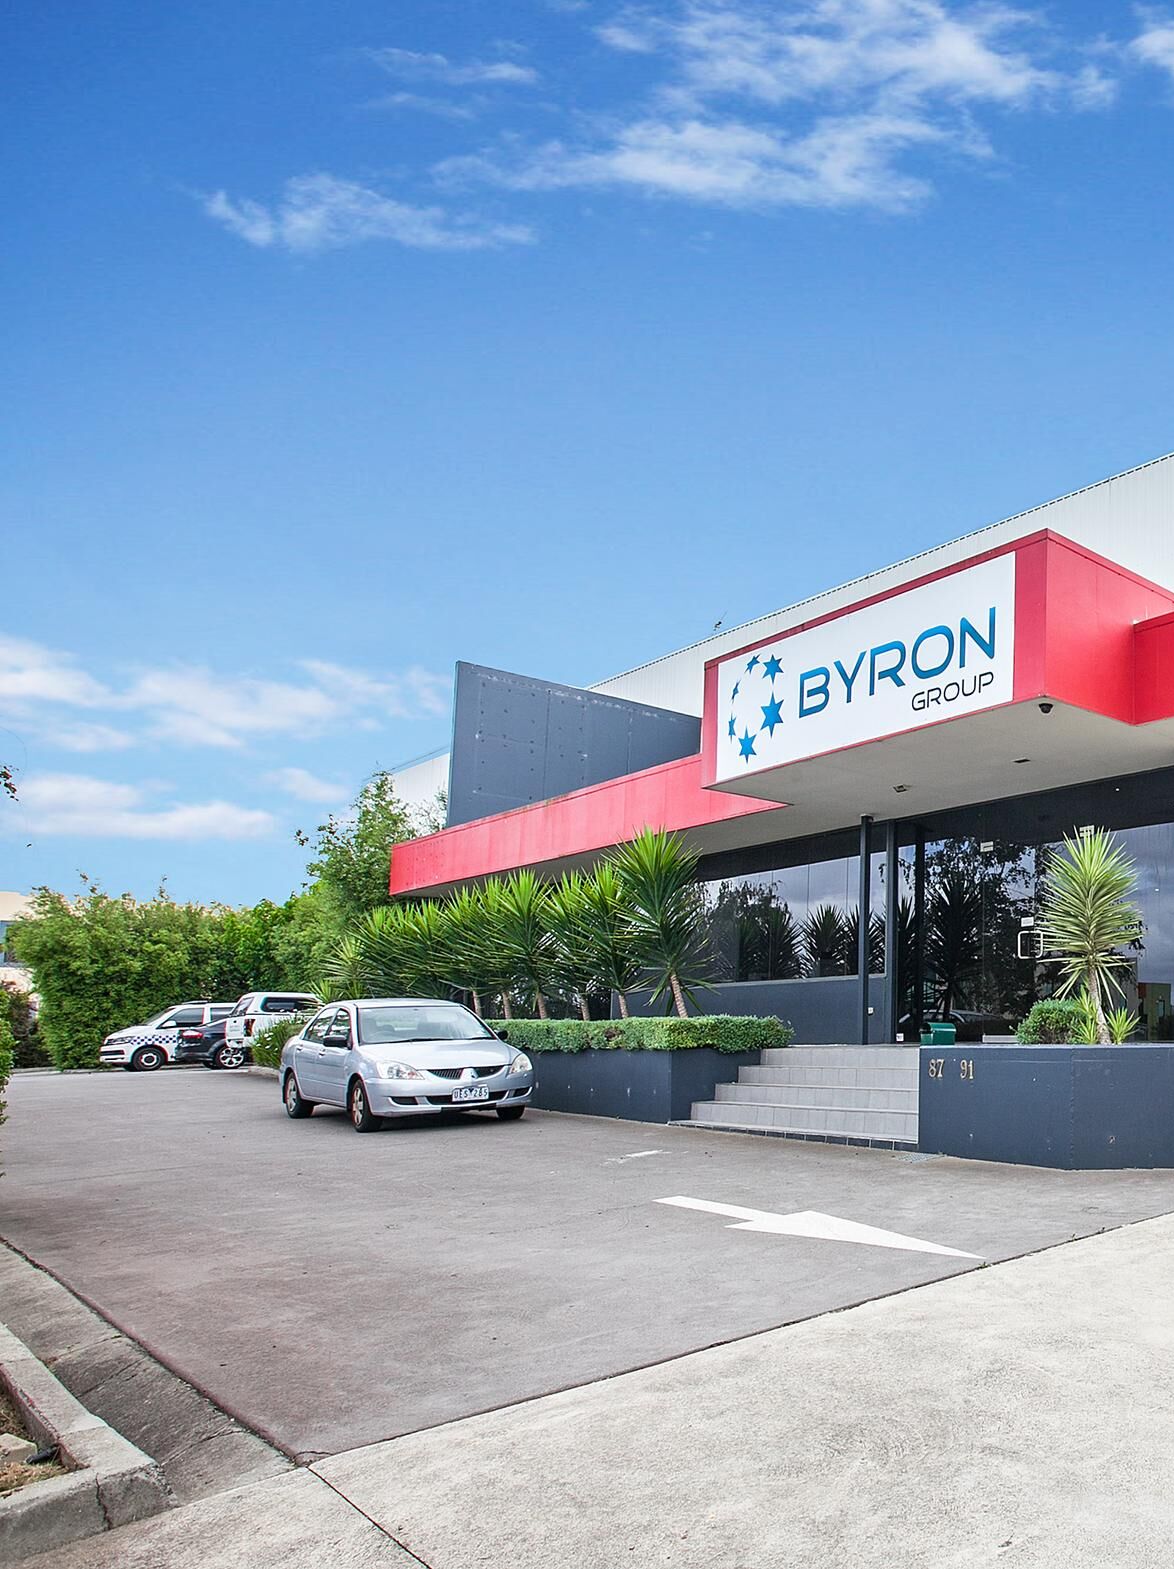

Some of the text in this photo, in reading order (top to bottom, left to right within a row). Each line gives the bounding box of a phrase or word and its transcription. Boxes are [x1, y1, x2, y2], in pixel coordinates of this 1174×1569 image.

[799, 606, 996, 719] BYRON
[911, 671, 994, 712] GROUP
[928, 1058, 974, 1080] 87 91
